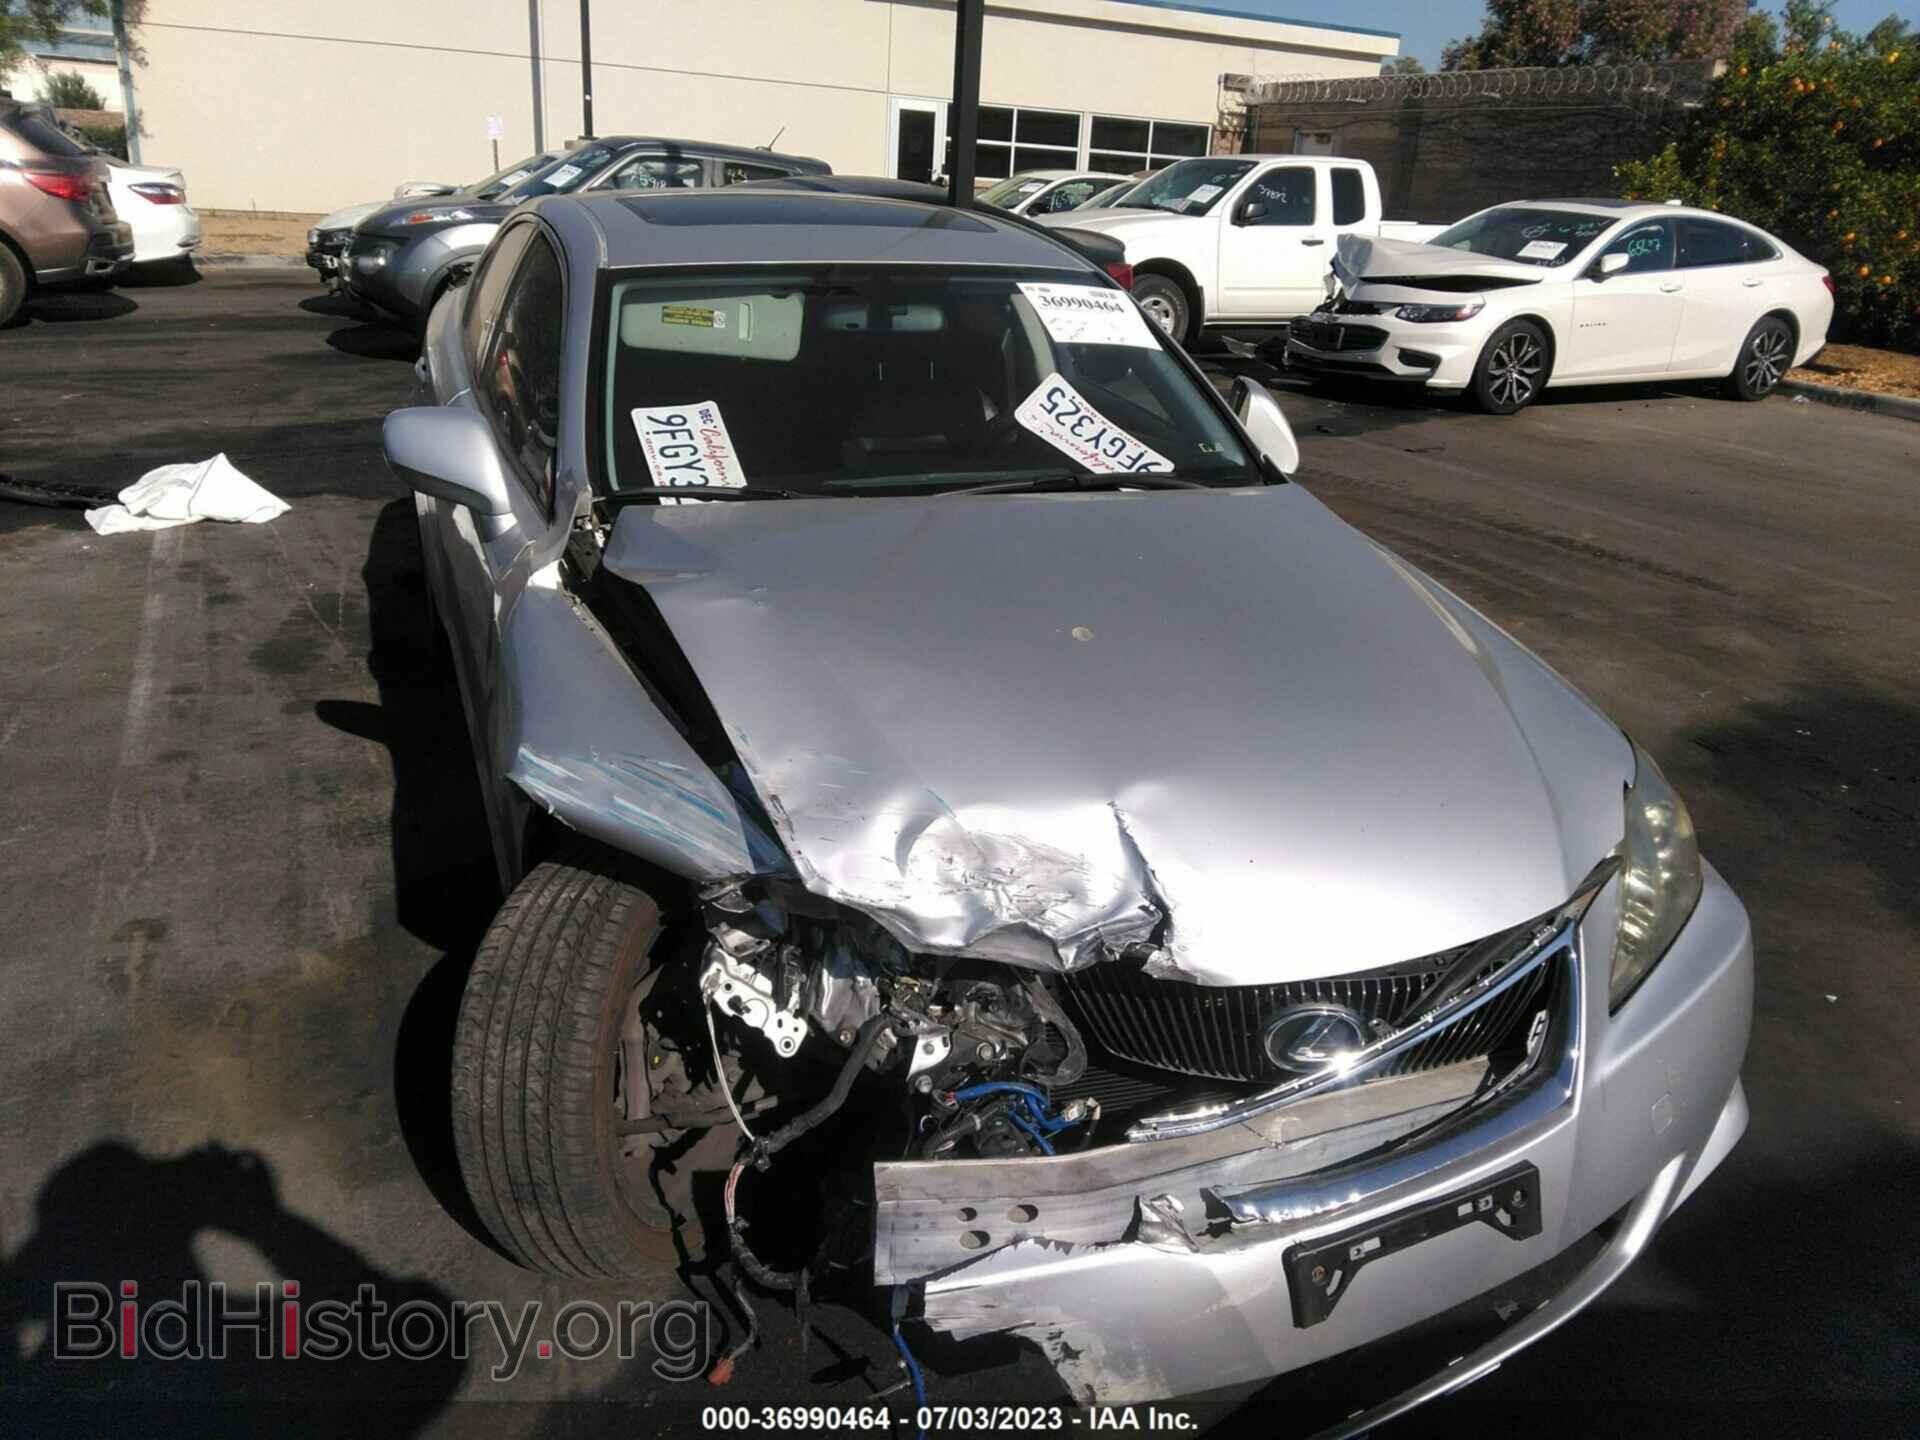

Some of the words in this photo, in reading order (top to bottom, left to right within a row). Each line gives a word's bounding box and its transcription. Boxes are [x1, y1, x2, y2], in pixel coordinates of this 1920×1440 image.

[1039, 295, 1125, 313] 36990464
[698, 408, 714, 425] DEC
[646, 413, 709, 488] 9FGY3
[1041, 423, 1115, 474] alifornia
